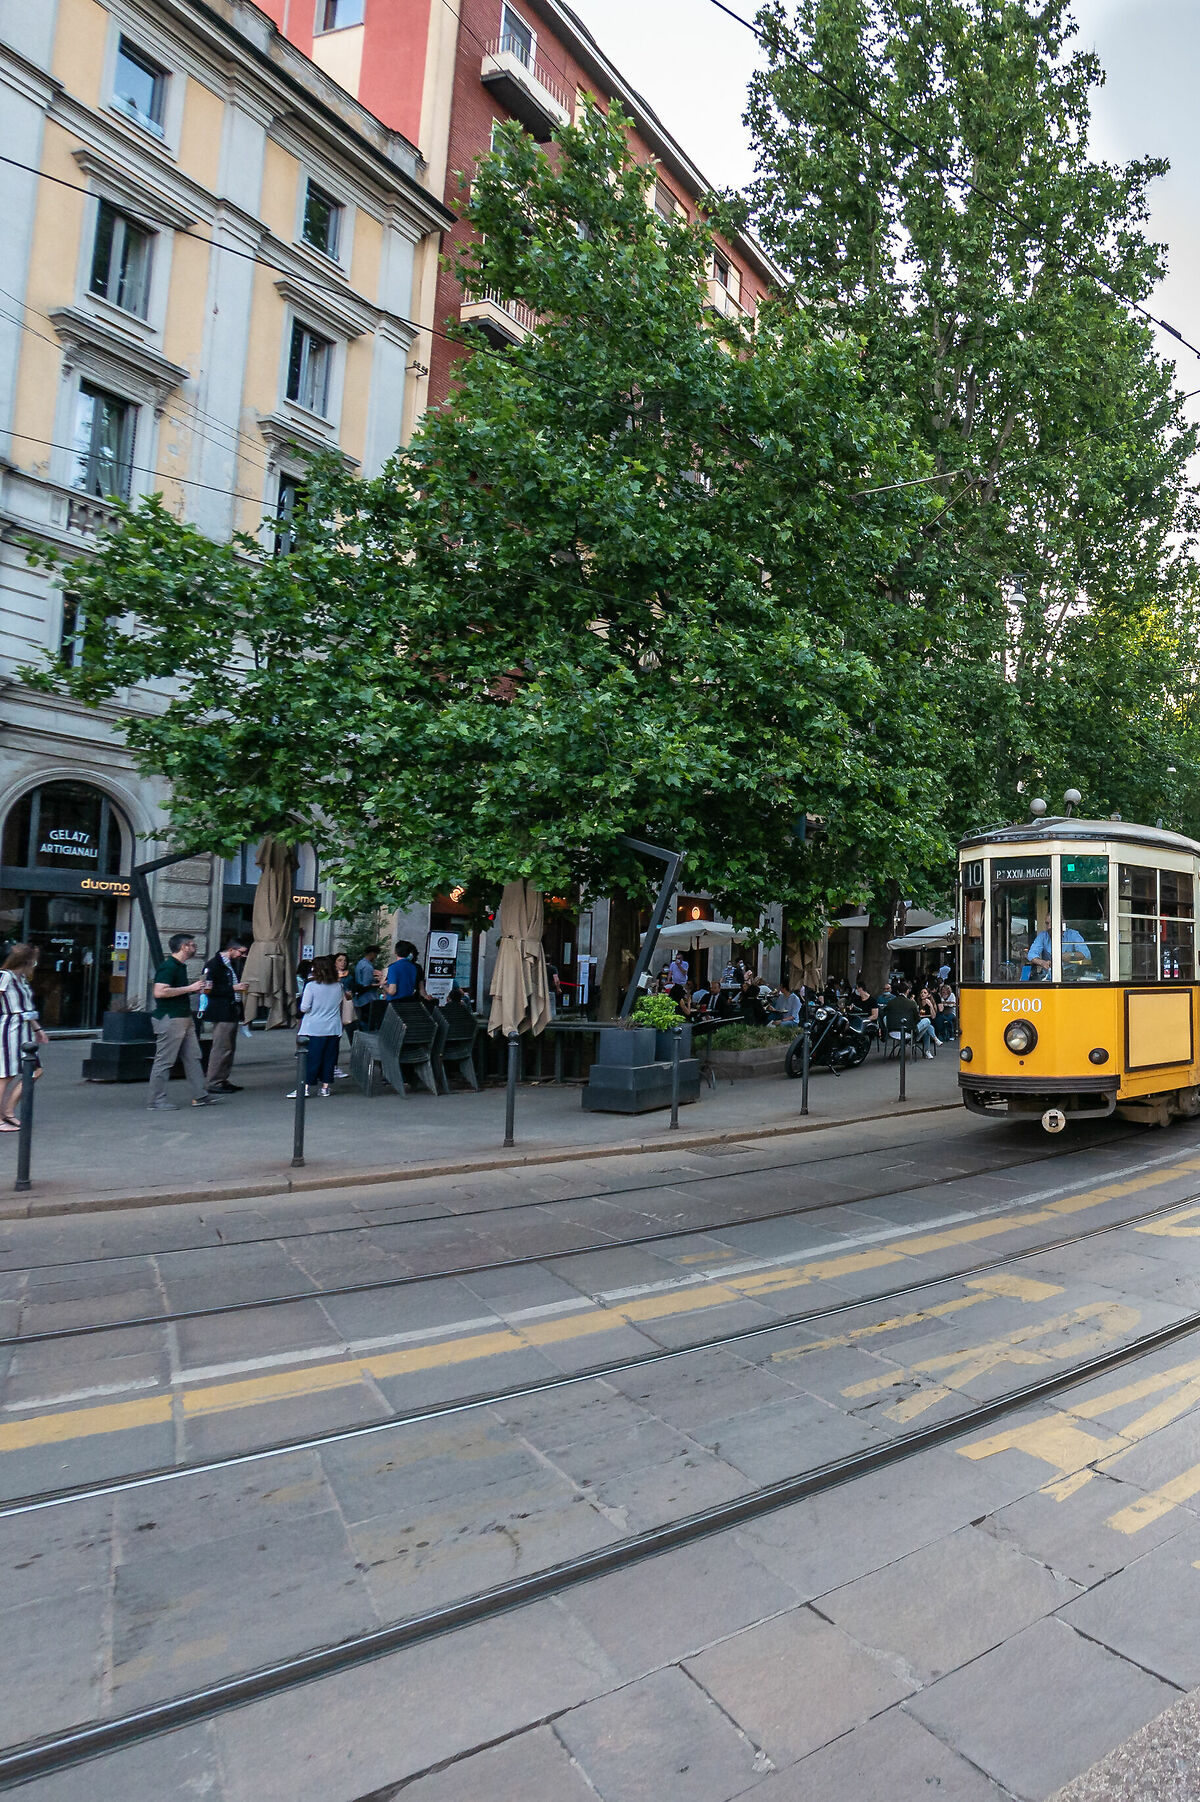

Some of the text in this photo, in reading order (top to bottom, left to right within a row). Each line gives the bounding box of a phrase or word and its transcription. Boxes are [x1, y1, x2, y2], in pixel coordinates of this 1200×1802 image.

[49, 829, 90, 844] GELATI
[40, 843, 98, 858] ARTIGIANALI
[968, 862, 982, 887] 10
[1026, 867, 1051, 878] MAGGIO
[81, 878, 131, 892] duomo
[292, 895, 316, 904] omo
[1001, 998, 1042, 1012] 2000
